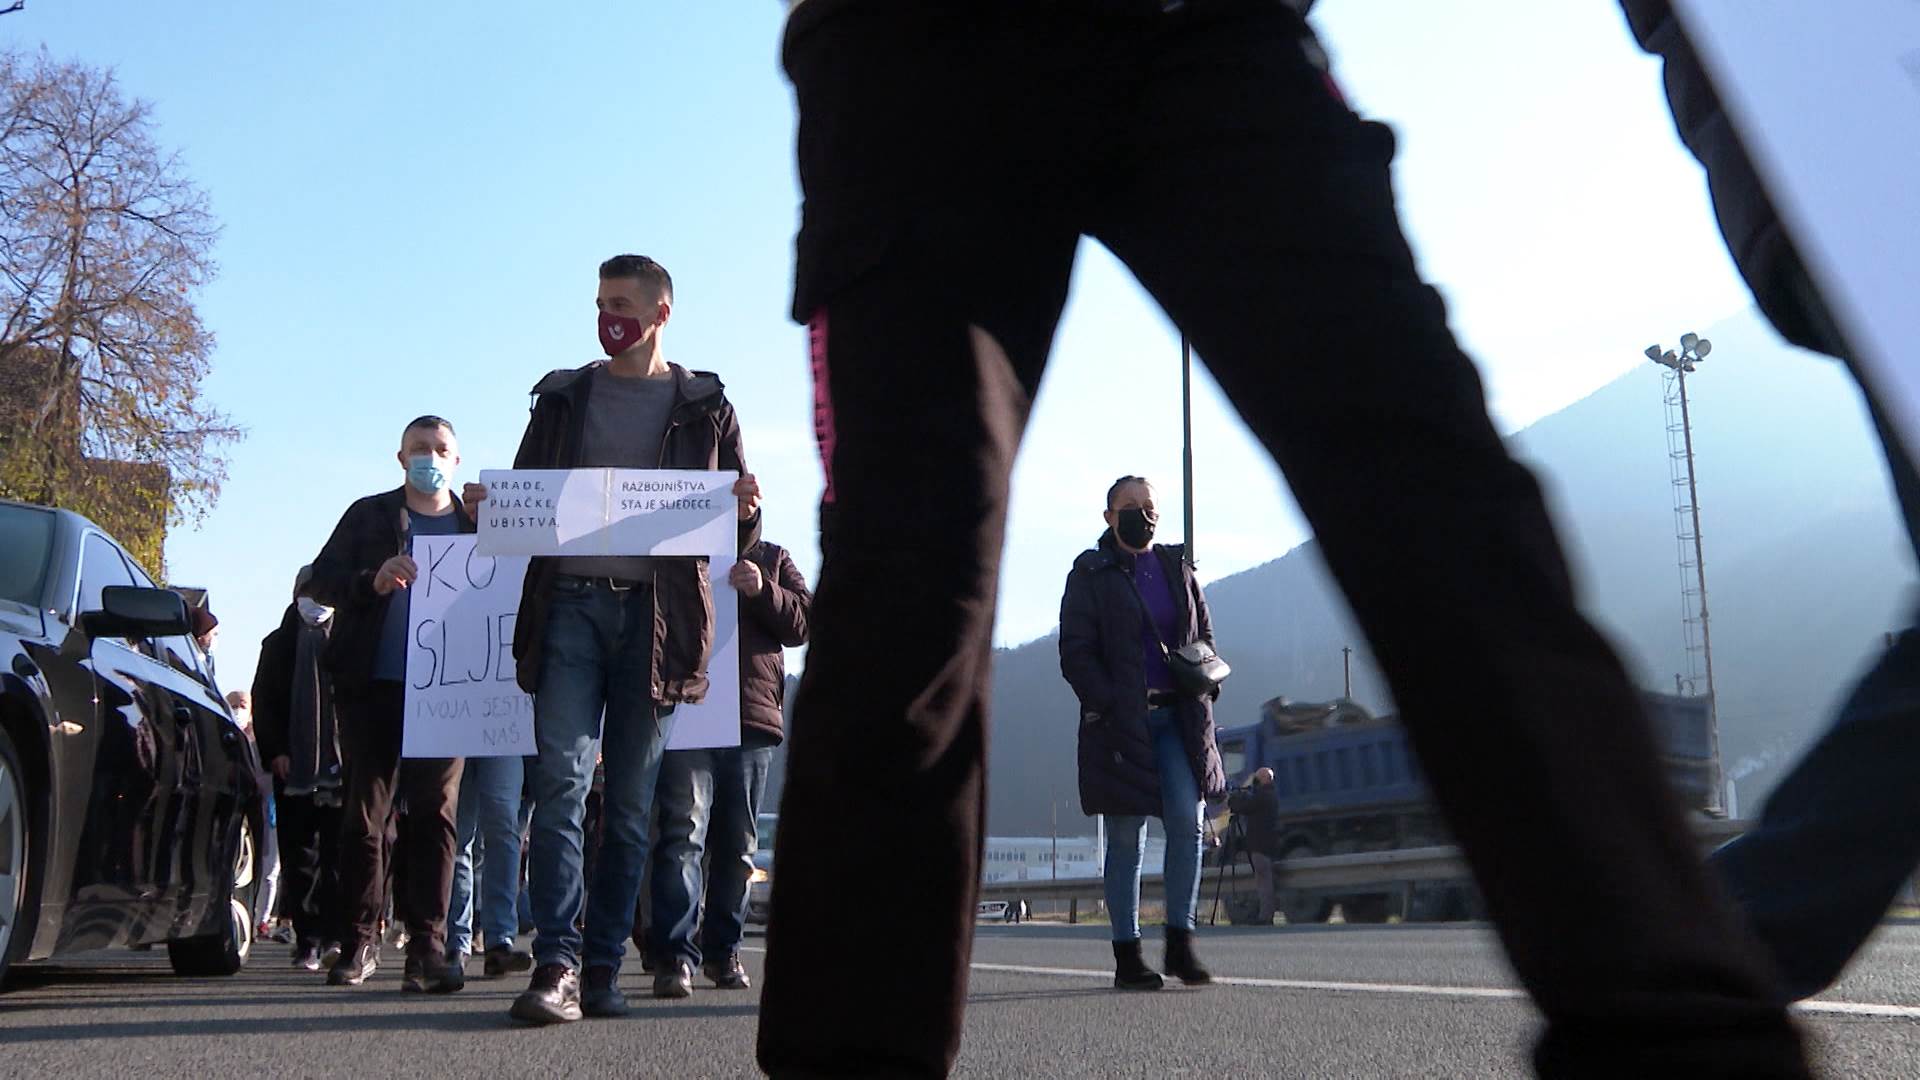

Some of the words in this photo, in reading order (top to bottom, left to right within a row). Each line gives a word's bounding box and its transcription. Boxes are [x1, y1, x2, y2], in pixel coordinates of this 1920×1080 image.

[622, 480, 706, 492] RAZBOJNIŠTVA
[645, 499, 656, 510] JE
[426, 541, 497, 598] KO
